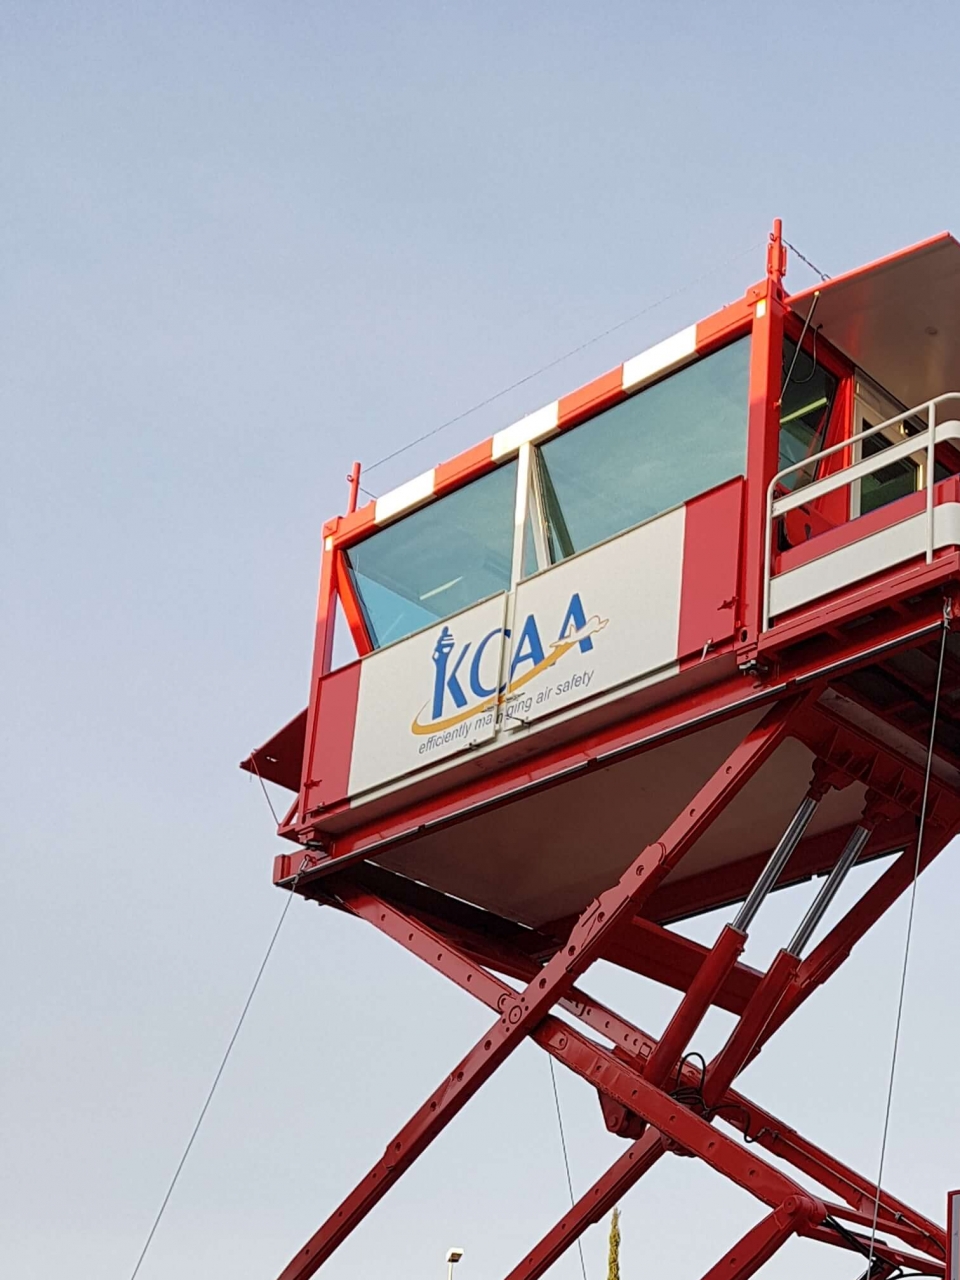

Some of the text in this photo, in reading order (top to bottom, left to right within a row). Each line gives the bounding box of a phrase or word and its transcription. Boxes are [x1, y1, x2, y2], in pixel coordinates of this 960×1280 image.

[432, 593, 594, 721] KCAA
[418, 669, 595, 755] efficiently managing air safety
